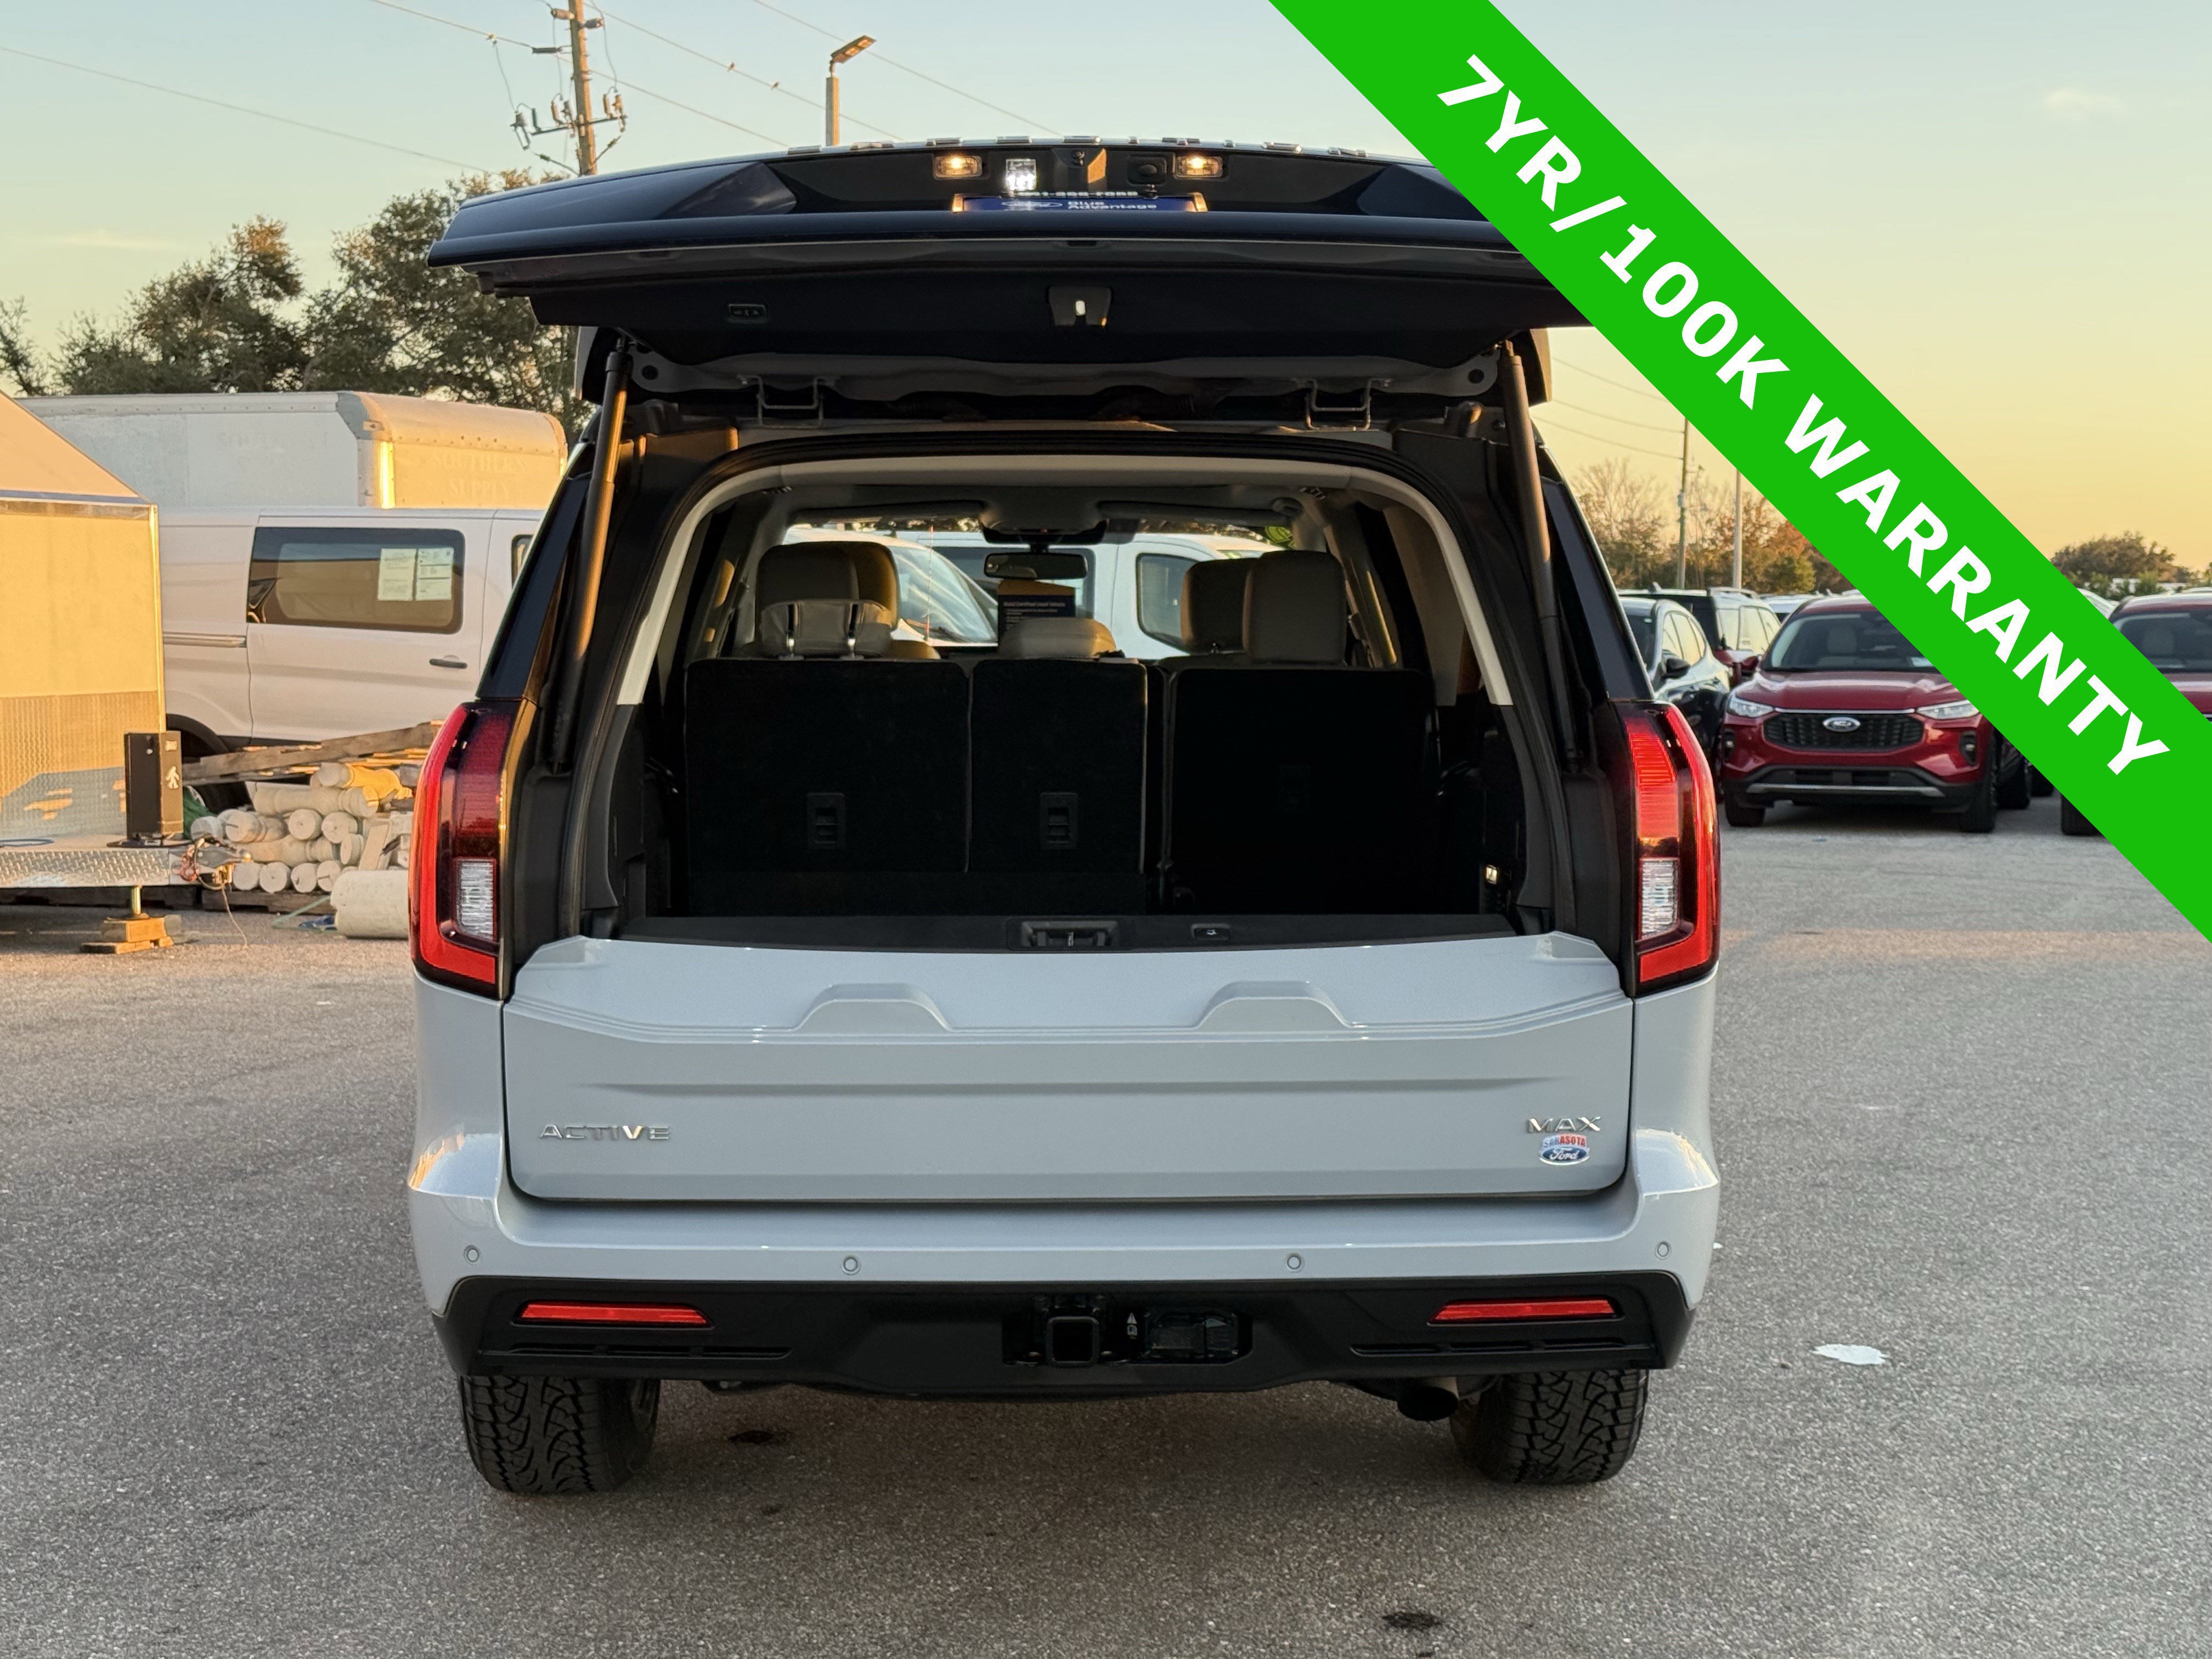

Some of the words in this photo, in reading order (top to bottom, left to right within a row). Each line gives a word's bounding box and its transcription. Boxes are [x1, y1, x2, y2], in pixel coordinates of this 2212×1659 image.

[540, 1124, 669, 1141] ACTIVE
[1528, 1115, 1602, 1133] MAX
[1549, 1147, 1580, 1160] Ford
